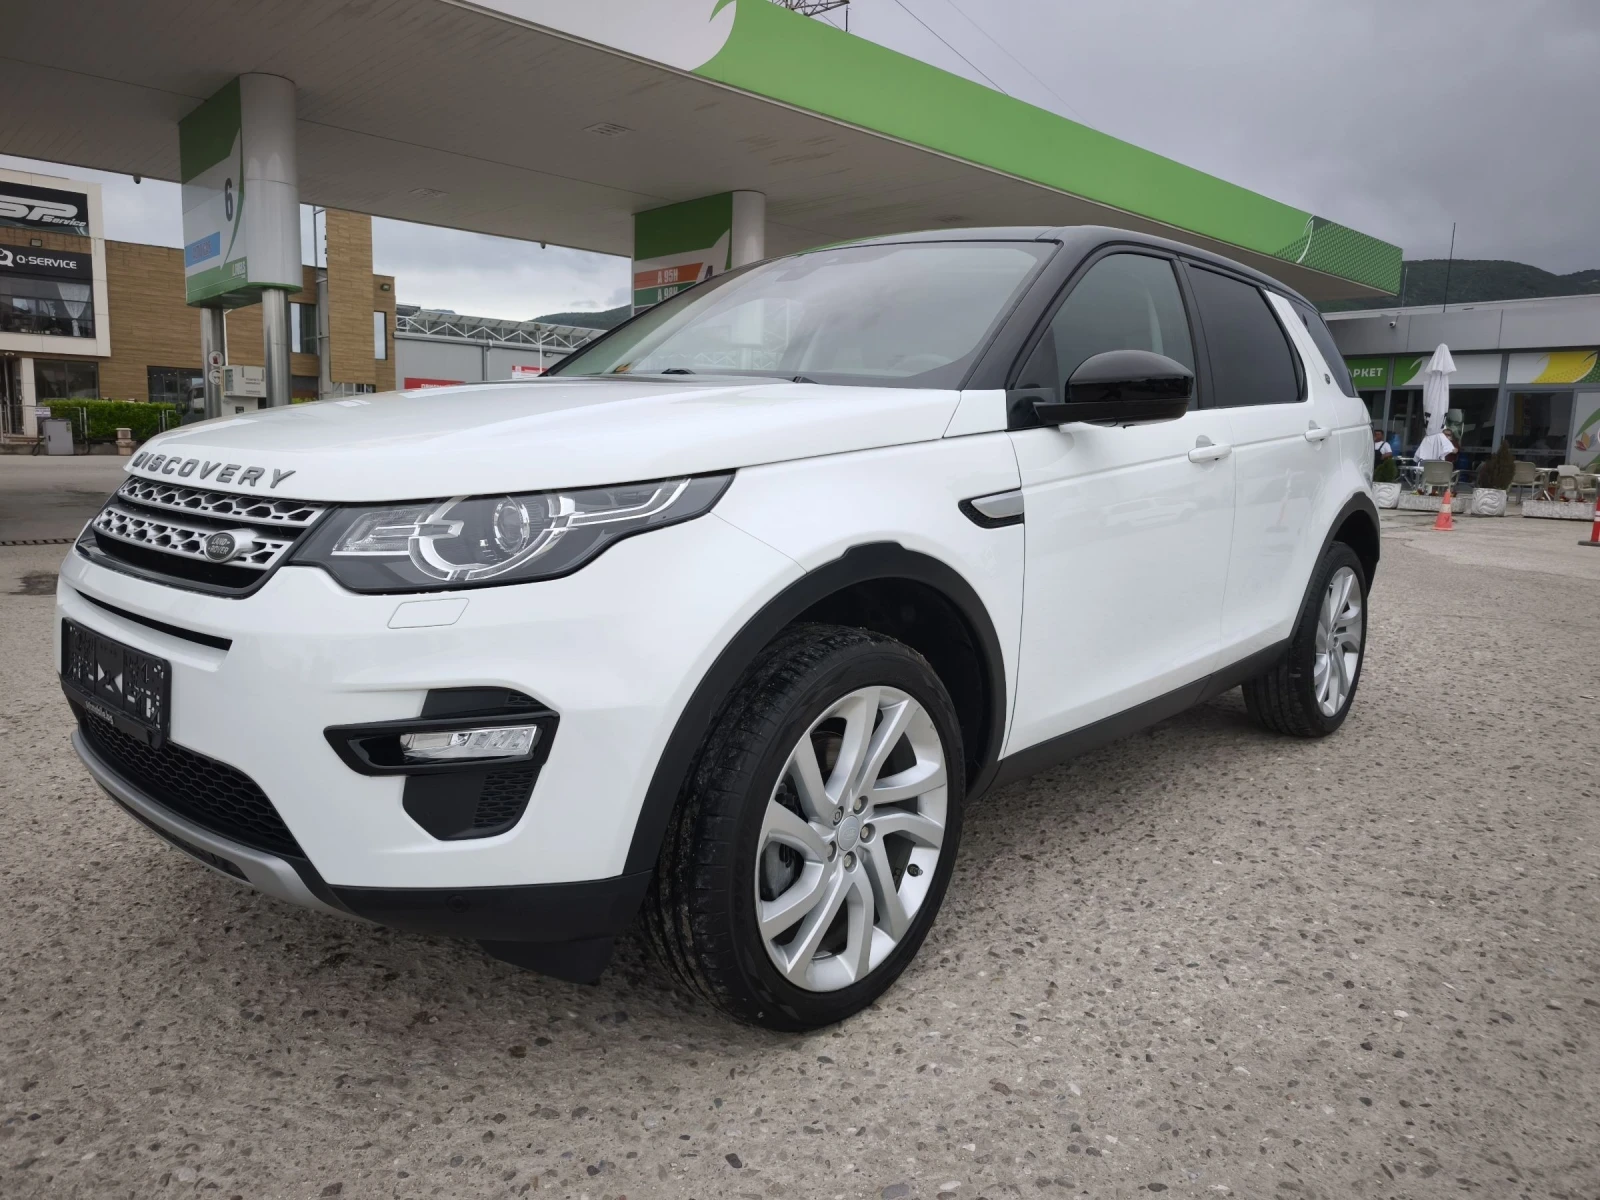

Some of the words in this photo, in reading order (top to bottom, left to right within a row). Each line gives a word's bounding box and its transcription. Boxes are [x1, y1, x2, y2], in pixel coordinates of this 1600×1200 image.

[224, 177, 234, 222] 6
[41, 215, 87, 227] Service
[131, 451, 297, 489] DISCOVERY
